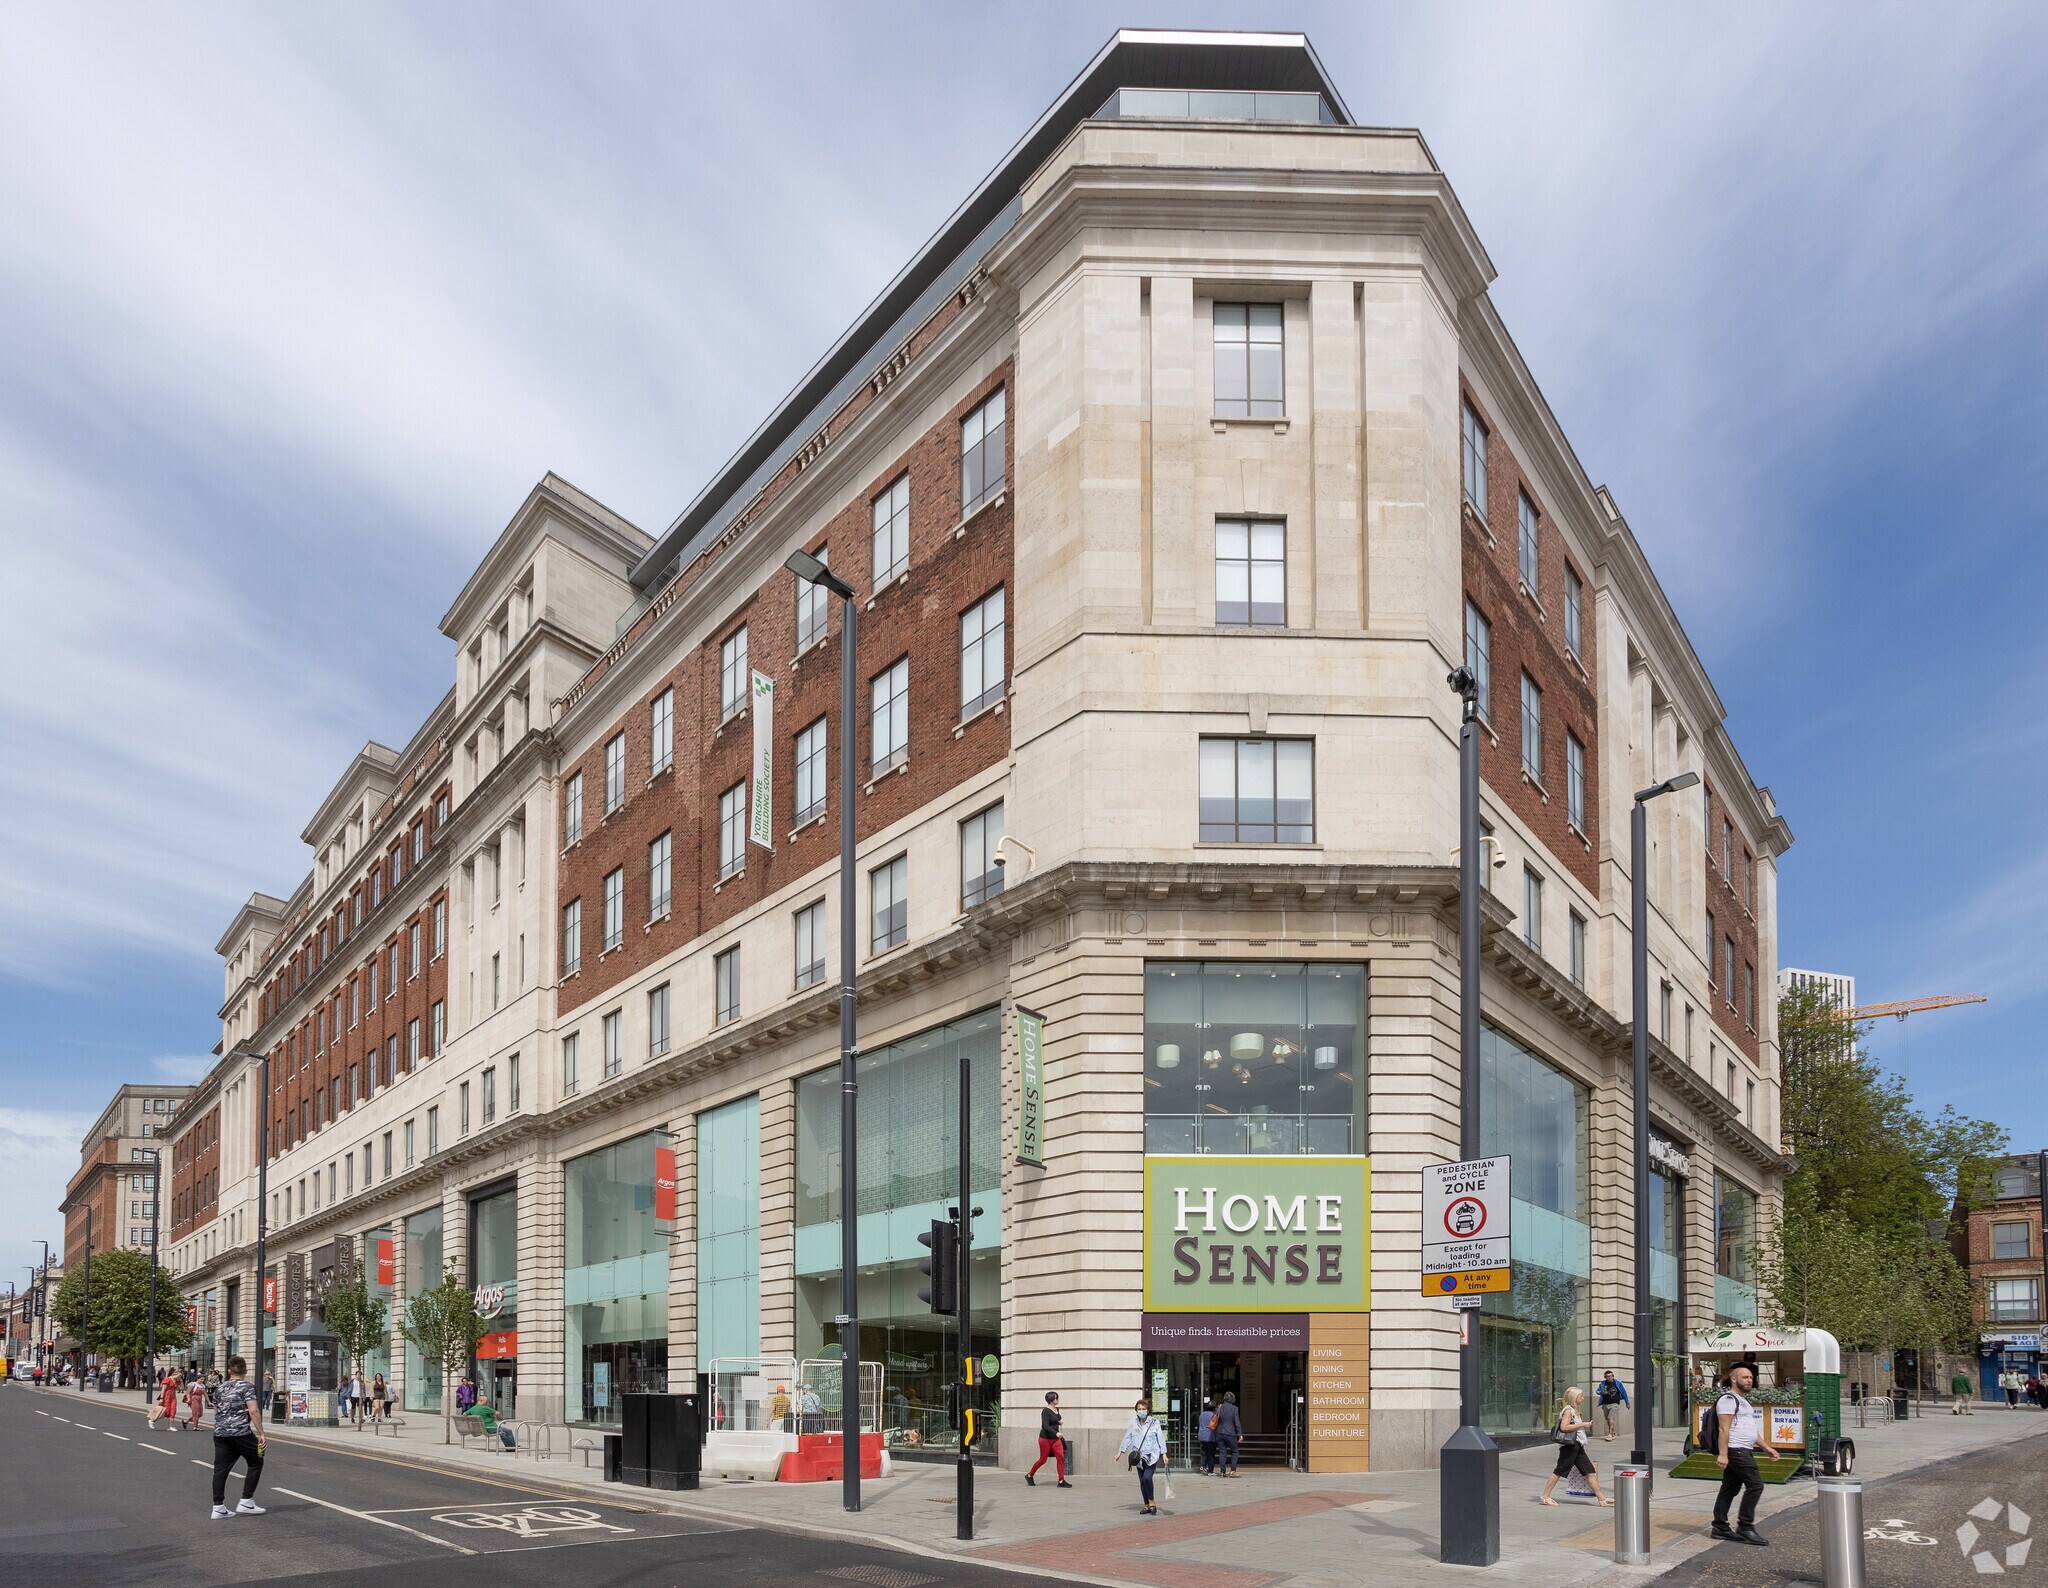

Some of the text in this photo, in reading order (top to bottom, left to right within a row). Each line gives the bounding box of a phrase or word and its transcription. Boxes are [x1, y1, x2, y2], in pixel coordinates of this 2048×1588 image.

[754, 779, 763, 837] YORKSHIRE
[762, 794, 770, 842] BUILDING
[1437, 1160, 1495, 1175] PEDESTRIAN
[1442, 1169, 1489, 1182] and CYCLE
[658, 1178, 675, 1186] Argos
[1444, 1180, 1486, 1195] ZONE
[1173, 1187, 1342, 1233] HOME
[1444, 1244, 1473, 1253] Except
[1173, 1236, 1342, 1283] SENSE
[1450, 1251, 1481, 1261] loading
[1425, 1260, 1462, 1271] Midnight
[1467, 1258, 1492, 1267] 10.30
[1476, 1273, 1491, 1282] any
[1468, 1282, 1487, 1290] time
[291, 1269, 300, 1318] BROAD GATE
[474, 1284, 504, 1310] Argos
[1151, 1326, 1301, 1338] Unique finds. Irresistible prices
[1705, 1336, 1735, 1350] Vegan
[1312, 1349, 1342, 1357] LIVING
[1312, 1365, 1344, 1373] DINING
[1312, 1381, 1352, 1389] KITCHEN
[1312, 1397, 1365, 1405] BATHROOM
[1312, 1413, 1360, 1421] BEDROOM
[1312, 1429, 1365, 1437] FURNITURE
